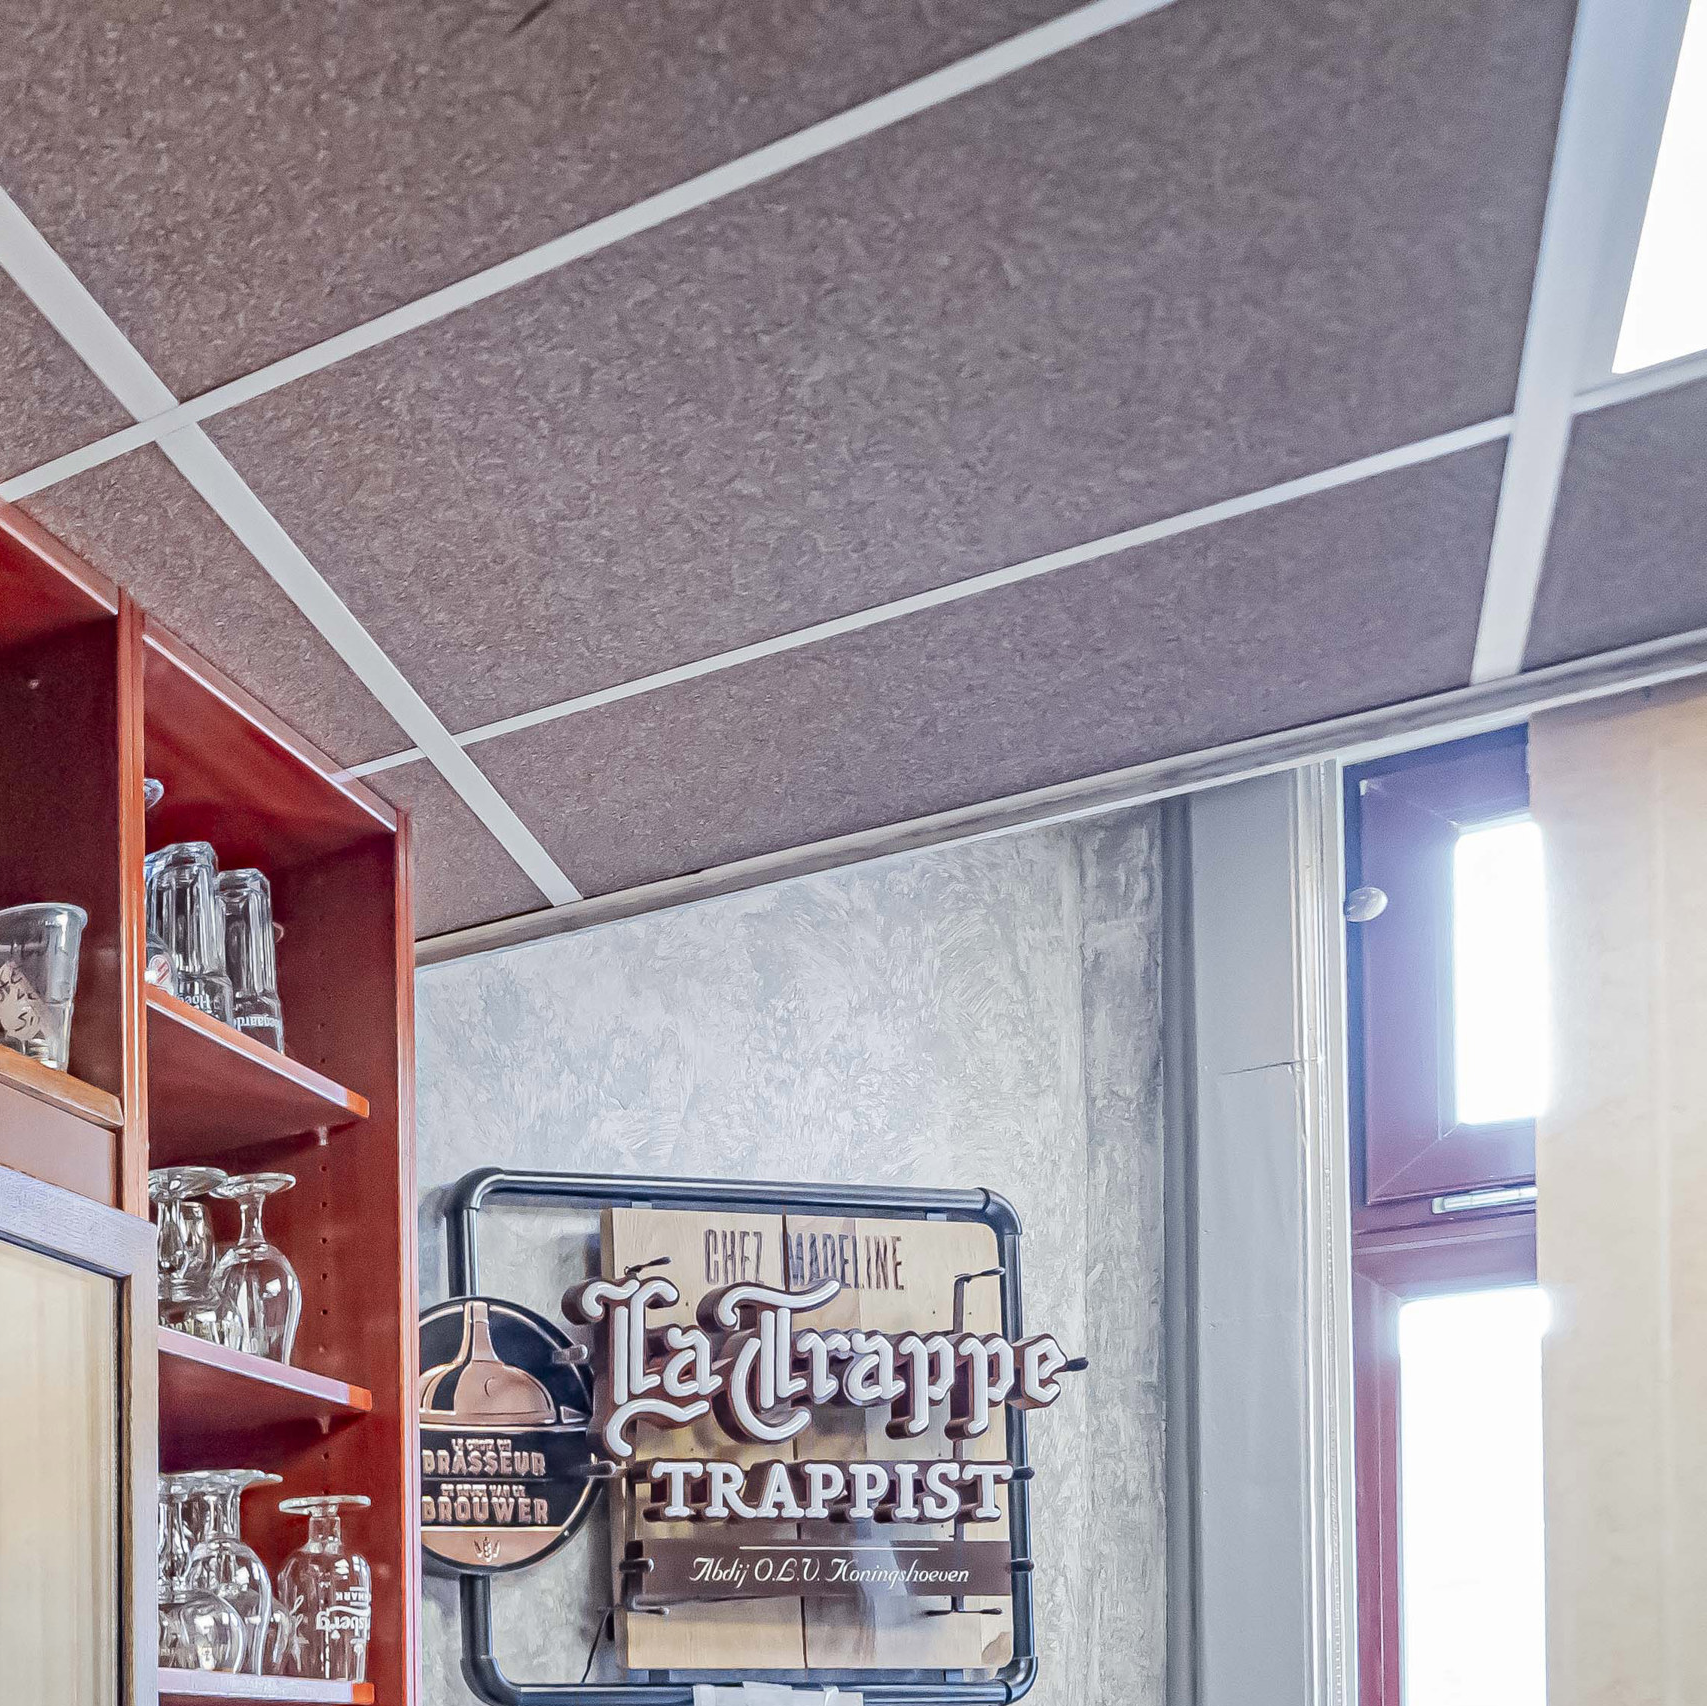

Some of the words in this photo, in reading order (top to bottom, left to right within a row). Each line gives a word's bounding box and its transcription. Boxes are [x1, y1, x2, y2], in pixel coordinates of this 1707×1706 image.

[704, 1228, 764, 1285] CHEZ
[781, 1231, 905, 1291] MADELINE
[579, 1276, 723, 1459] La
[715, 1277, 1070, 1443] Trappe
[421, 1495, 549, 1525] BROUWER
[649, 1460, 1014, 1522] TRAPPIST
[688, 1556, 750, 1589] Abdij
